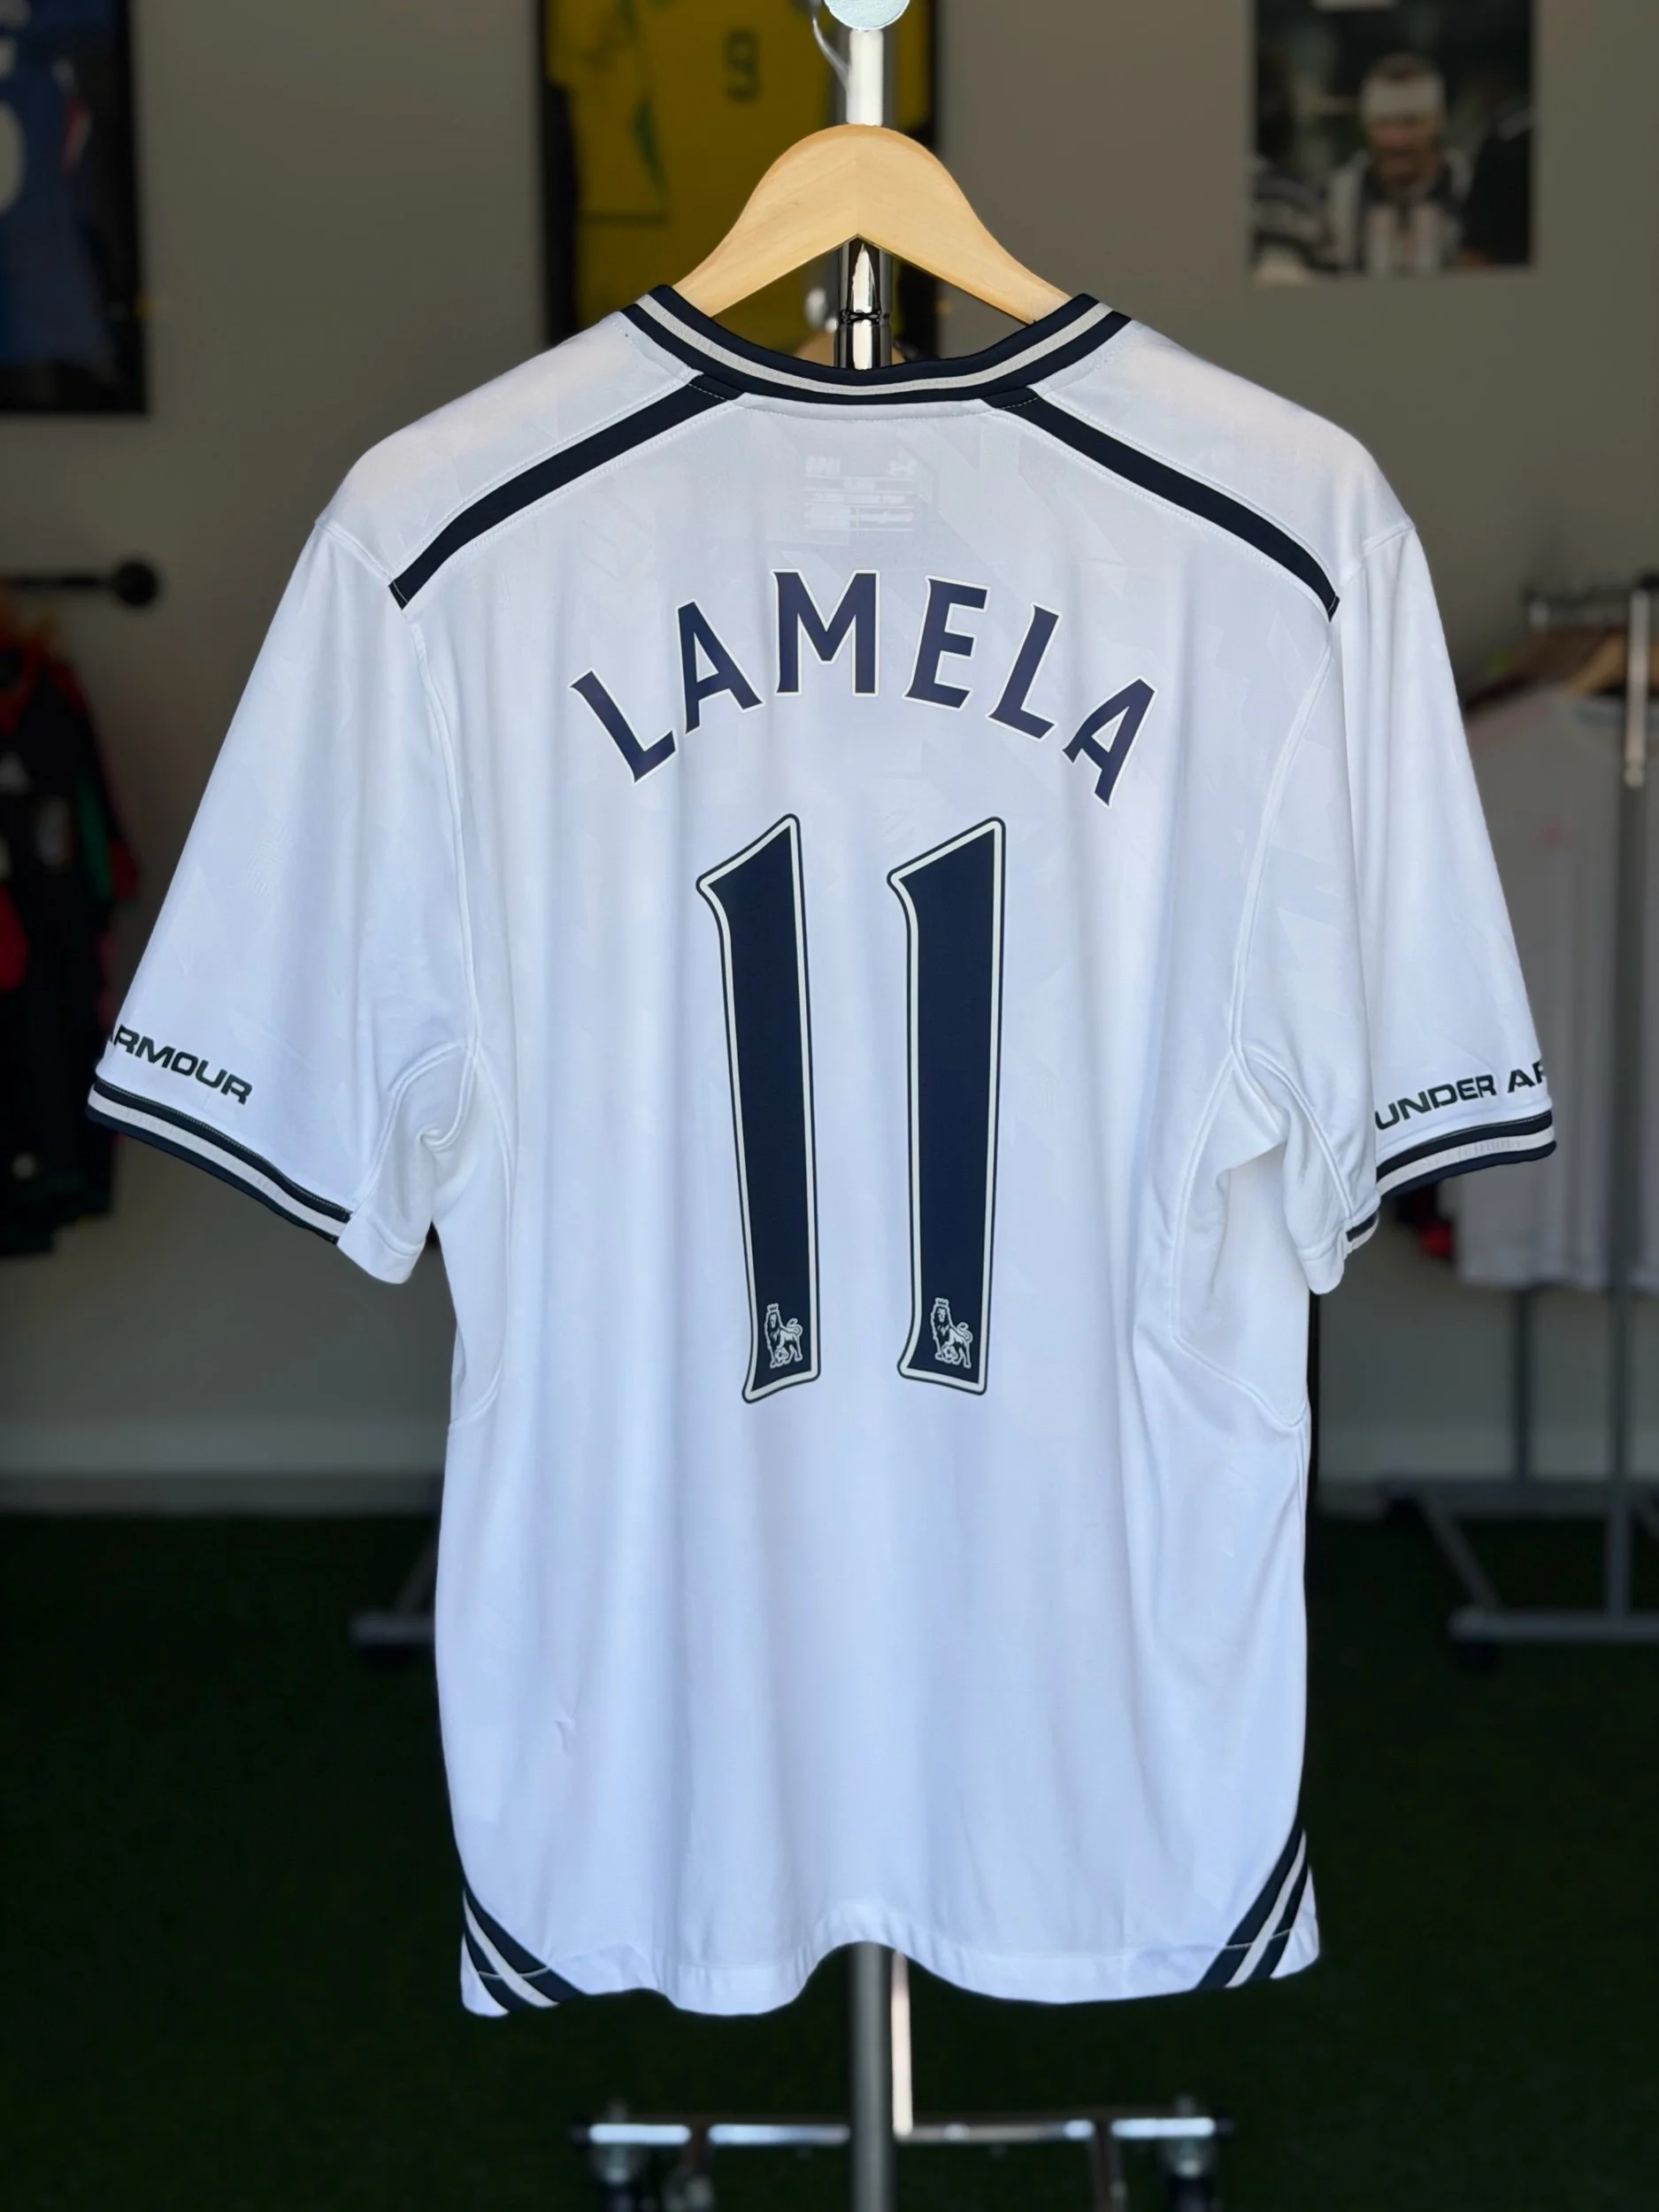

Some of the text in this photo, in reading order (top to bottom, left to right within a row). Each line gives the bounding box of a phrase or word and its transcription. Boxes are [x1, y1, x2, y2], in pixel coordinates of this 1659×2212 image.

[569, 570, 1156, 807] LAMELA
[107, 1024, 254, 1106] RMOUR
[695, 812, 1007, 1405] 11
[1374, 1074, 1498, 1131] UNDER
